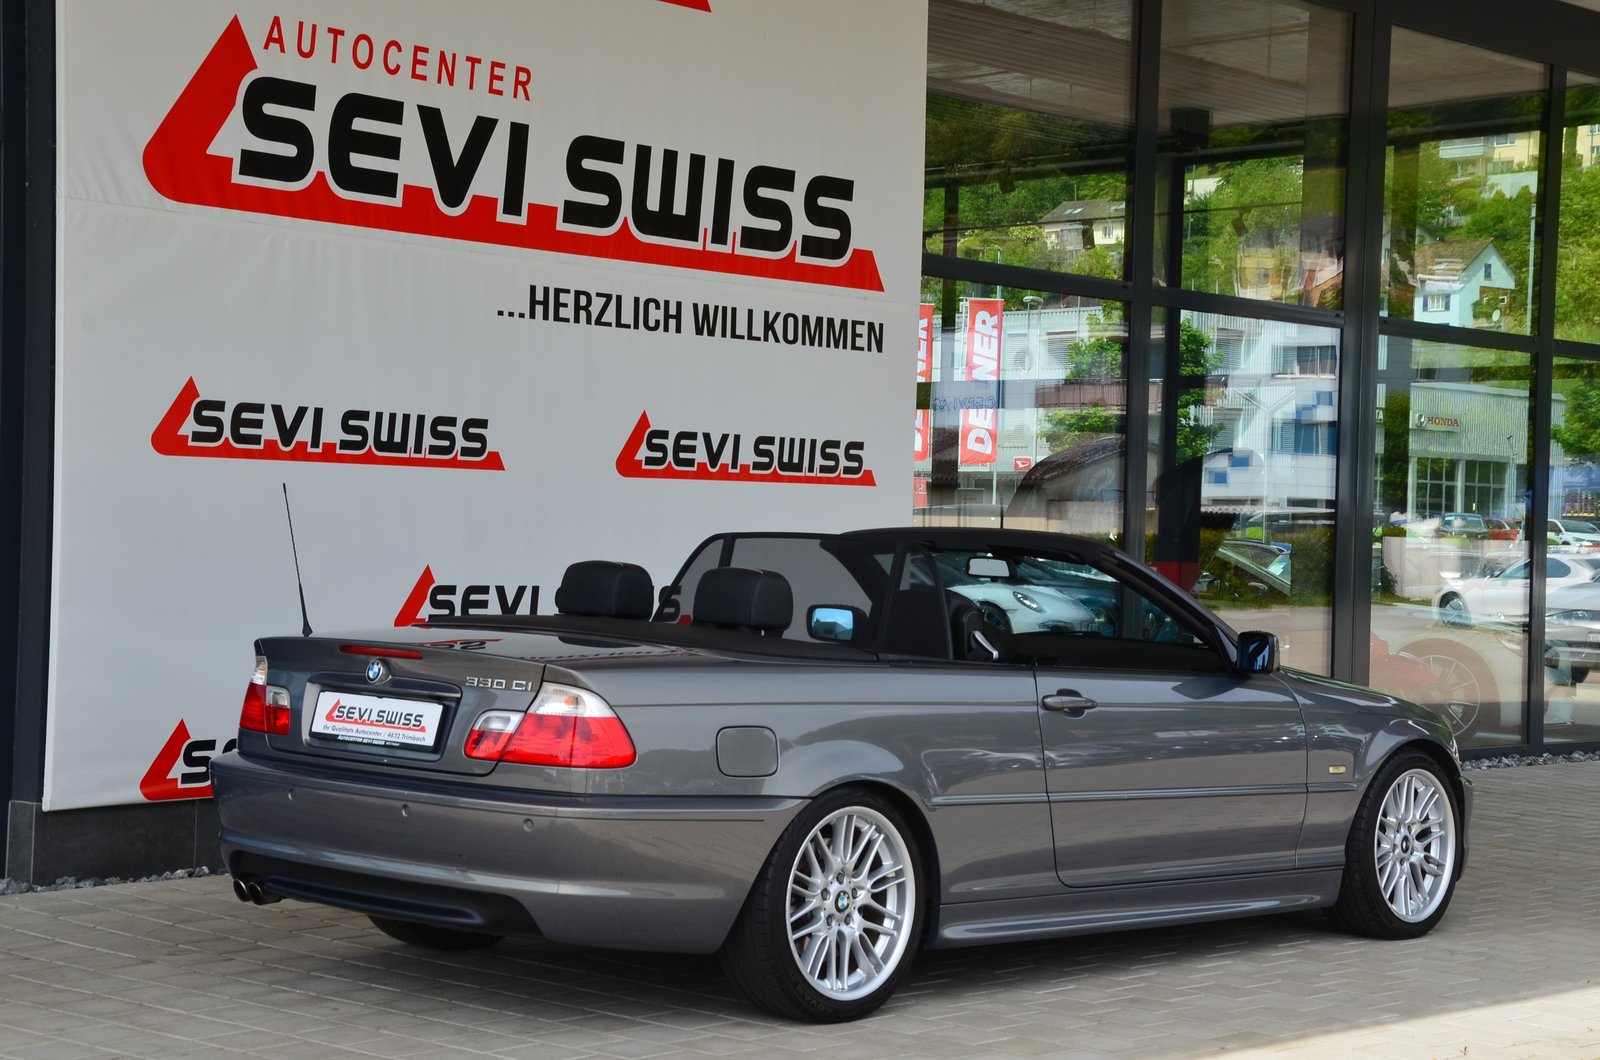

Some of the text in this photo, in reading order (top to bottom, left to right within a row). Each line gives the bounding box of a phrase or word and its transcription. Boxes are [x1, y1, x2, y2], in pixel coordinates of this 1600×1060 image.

[263, 15, 532, 102] AUTOCENTER
[239, 76, 855, 261] SEVI SWISS
[497, 284, 884, 354] ...HERZLICH WILLKOMMEN
[967, 310, 999, 455] DENER
[190, 399, 489, 458] SEVI SWISS
[1427, 416, 1459, 427] HONDA
[644, 429, 865, 476] SEVI SWISS
[429, 585, 540, 616] SEVI
[465, 676, 505, 689] 330
[335, 705, 424, 728] SEVI SWISS
[355, 727, 383, 737] Autocenter
[401, 732, 426, 743] Trimbach
